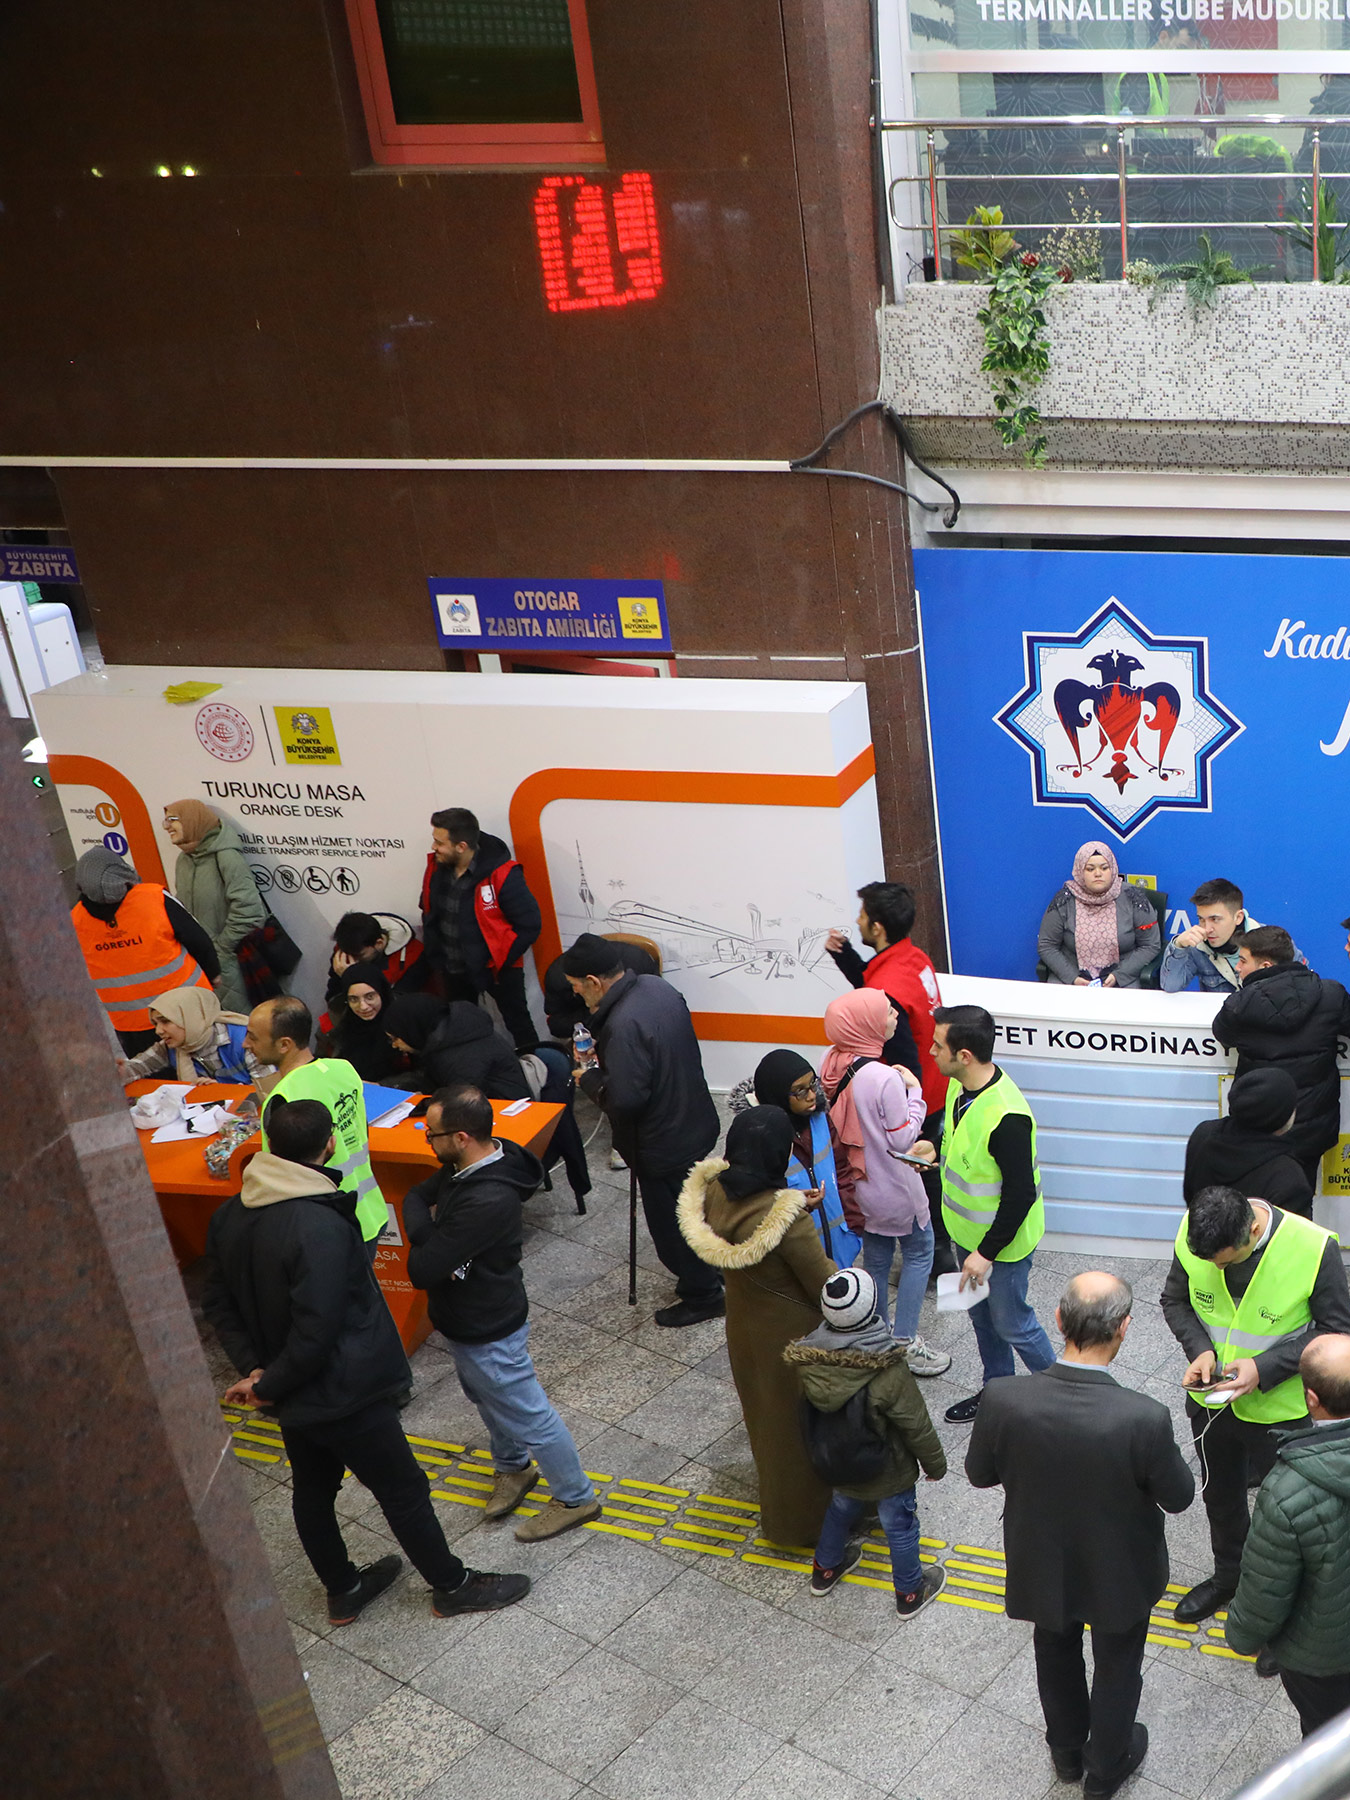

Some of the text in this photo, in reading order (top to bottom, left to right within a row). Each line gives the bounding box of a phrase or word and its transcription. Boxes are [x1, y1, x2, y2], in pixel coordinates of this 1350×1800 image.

[1160, 0, 1225, 27] ŞUBE
[6, 551, 68, 562] BÜYÜKŞEHİR
[8, 560, 76, 578] ZABITA
[513, 590, 581, 611] OTOGAR
[485, 613, 618, 639] ZABITA AMİRLİĞİ
[286, 744, 336, 754] BÜYÜKŞEHİR
[202, 781, 366, 802] TURUNCU MASA
[239, 803, 344, 818] ORANGE DESK
[267, 835, 308, 848] ULAŞIM
[311, 834, 352, 847] HİZMET
[356, 837, 405, 849] NOKTASI
[241, 846, 386, 858] SIBLE TRANSPORT SERVICE POINT
[95, 935, 144, 951] GÖREVLİ
[993, 1025, 1037, 1046] FET
[1049, 1029, 1230, 1058] KOORDİNAS
[375, 1251, 400, 1261] ASA
